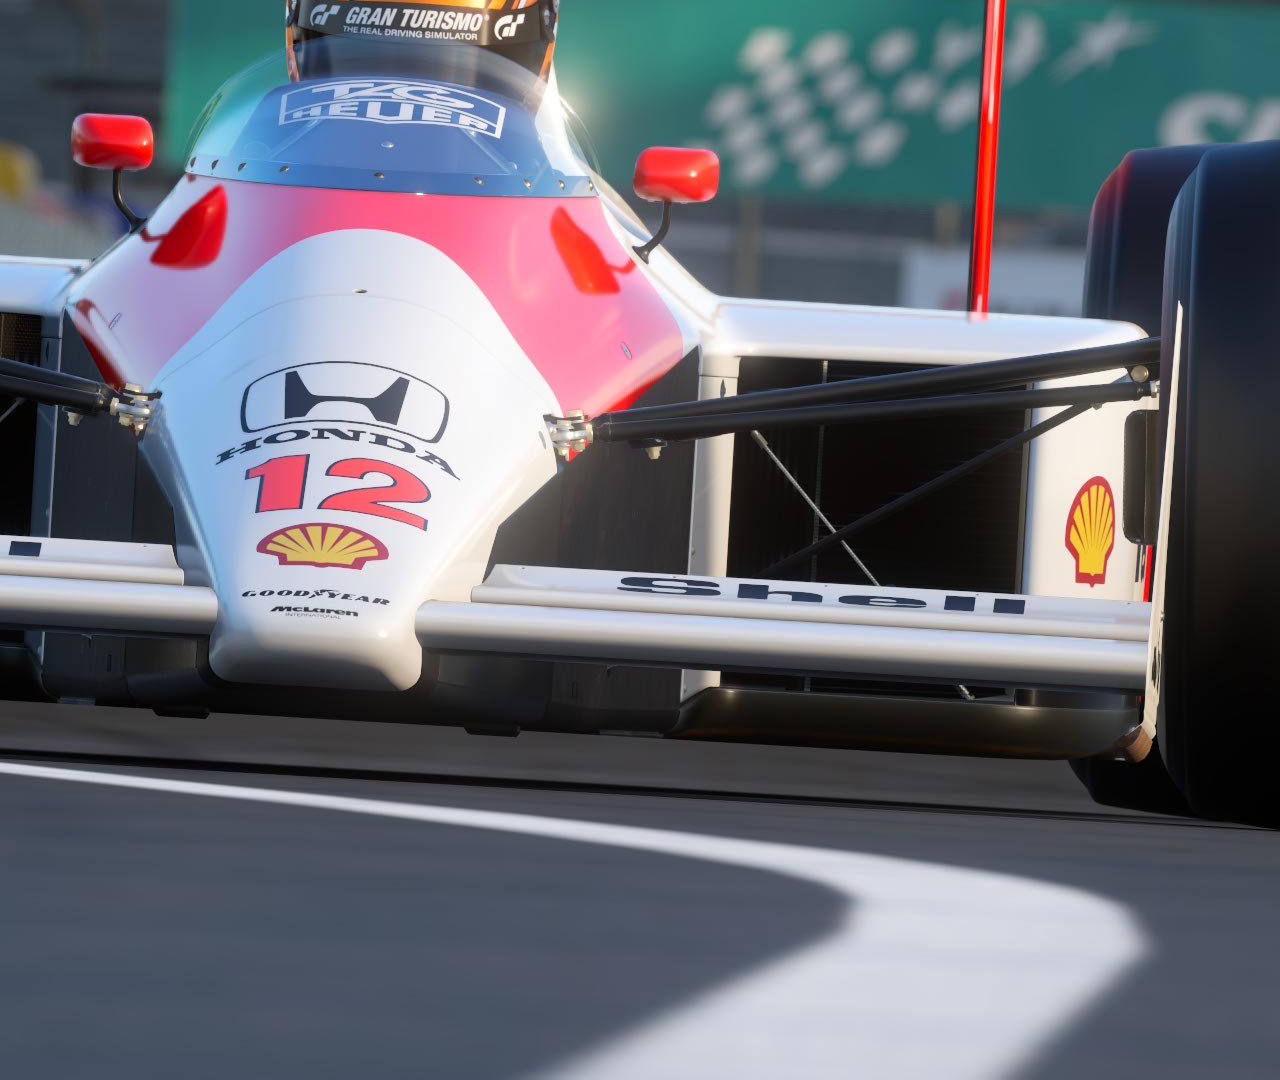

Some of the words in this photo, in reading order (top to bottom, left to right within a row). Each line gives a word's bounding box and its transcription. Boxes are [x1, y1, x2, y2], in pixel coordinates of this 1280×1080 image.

[345, 6, 397, 27] GRAN
[343, 25, 359, 34] THE
[360, 27, 382, 36] REAL
[384, 28, 423, 39] DRIVING
[424, 31, 478, 41] SIMULATOR
[312, 83, 474, 109] TAG
[293, 101, 488, 131] HEUER
[215, 427, 461, 481] HONDA
[245, 453, 432, 532] 12
[241, 589, 391, 606] GOODYEAR
[617, 576, 1026, 615] Shell
[270, 605, 359, 617] McLaren
[284, 612, 342, 620] INTERNATIONAL
